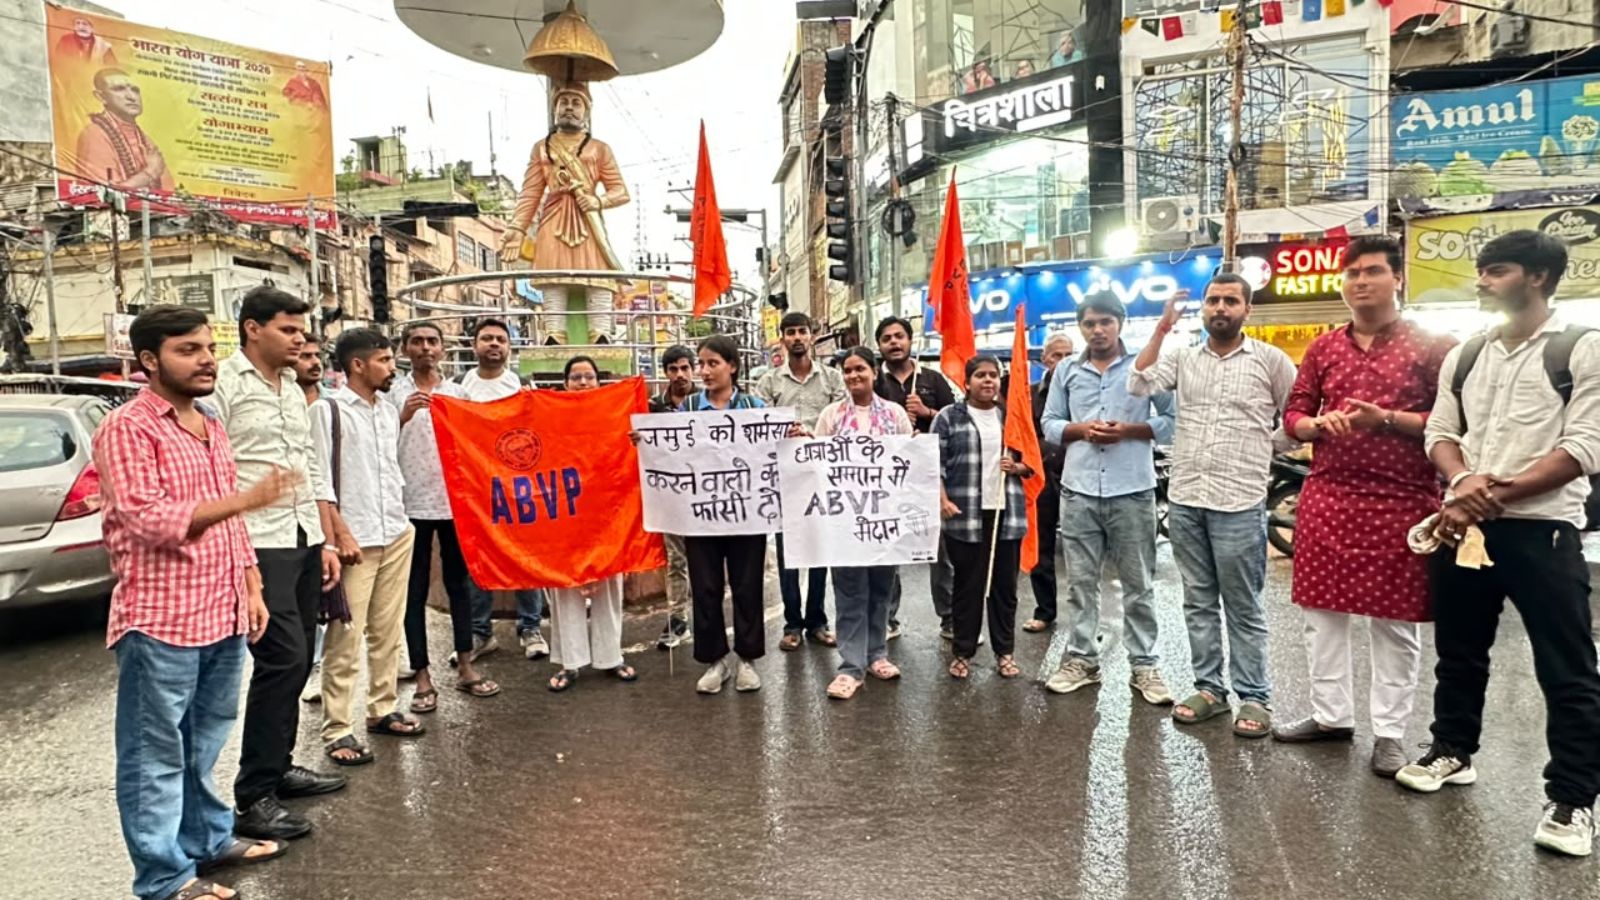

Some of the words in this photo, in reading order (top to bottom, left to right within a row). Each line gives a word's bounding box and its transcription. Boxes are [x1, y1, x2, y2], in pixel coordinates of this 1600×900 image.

[131, 38, 171, 55] भारत
[175, 44, 206, 63] योग
[209, 53, 241, 69] यात्रा
[244, 62, 272, 75] 2026
[942, 75, 1075, 138] चित्रशाला
[1396, 88, 1537, 138] Amul
[1276, 275, 1319, 295] FAST
[1322, 273, 1346, 293] FO
[968, 289, 1011, 315] vo
[638, 419, 696, 451] जमुई
[708, 414, 736, 443] को
[741, 413, 795, 444] शर्मसा
[855, 435, 885, 463] के
[644, 463, 697, 495] करने
[491, 467, 582, 524] ABVP
[691, 492, 752, 523] फांसी
[804, 489, 890, 517] ABVP
